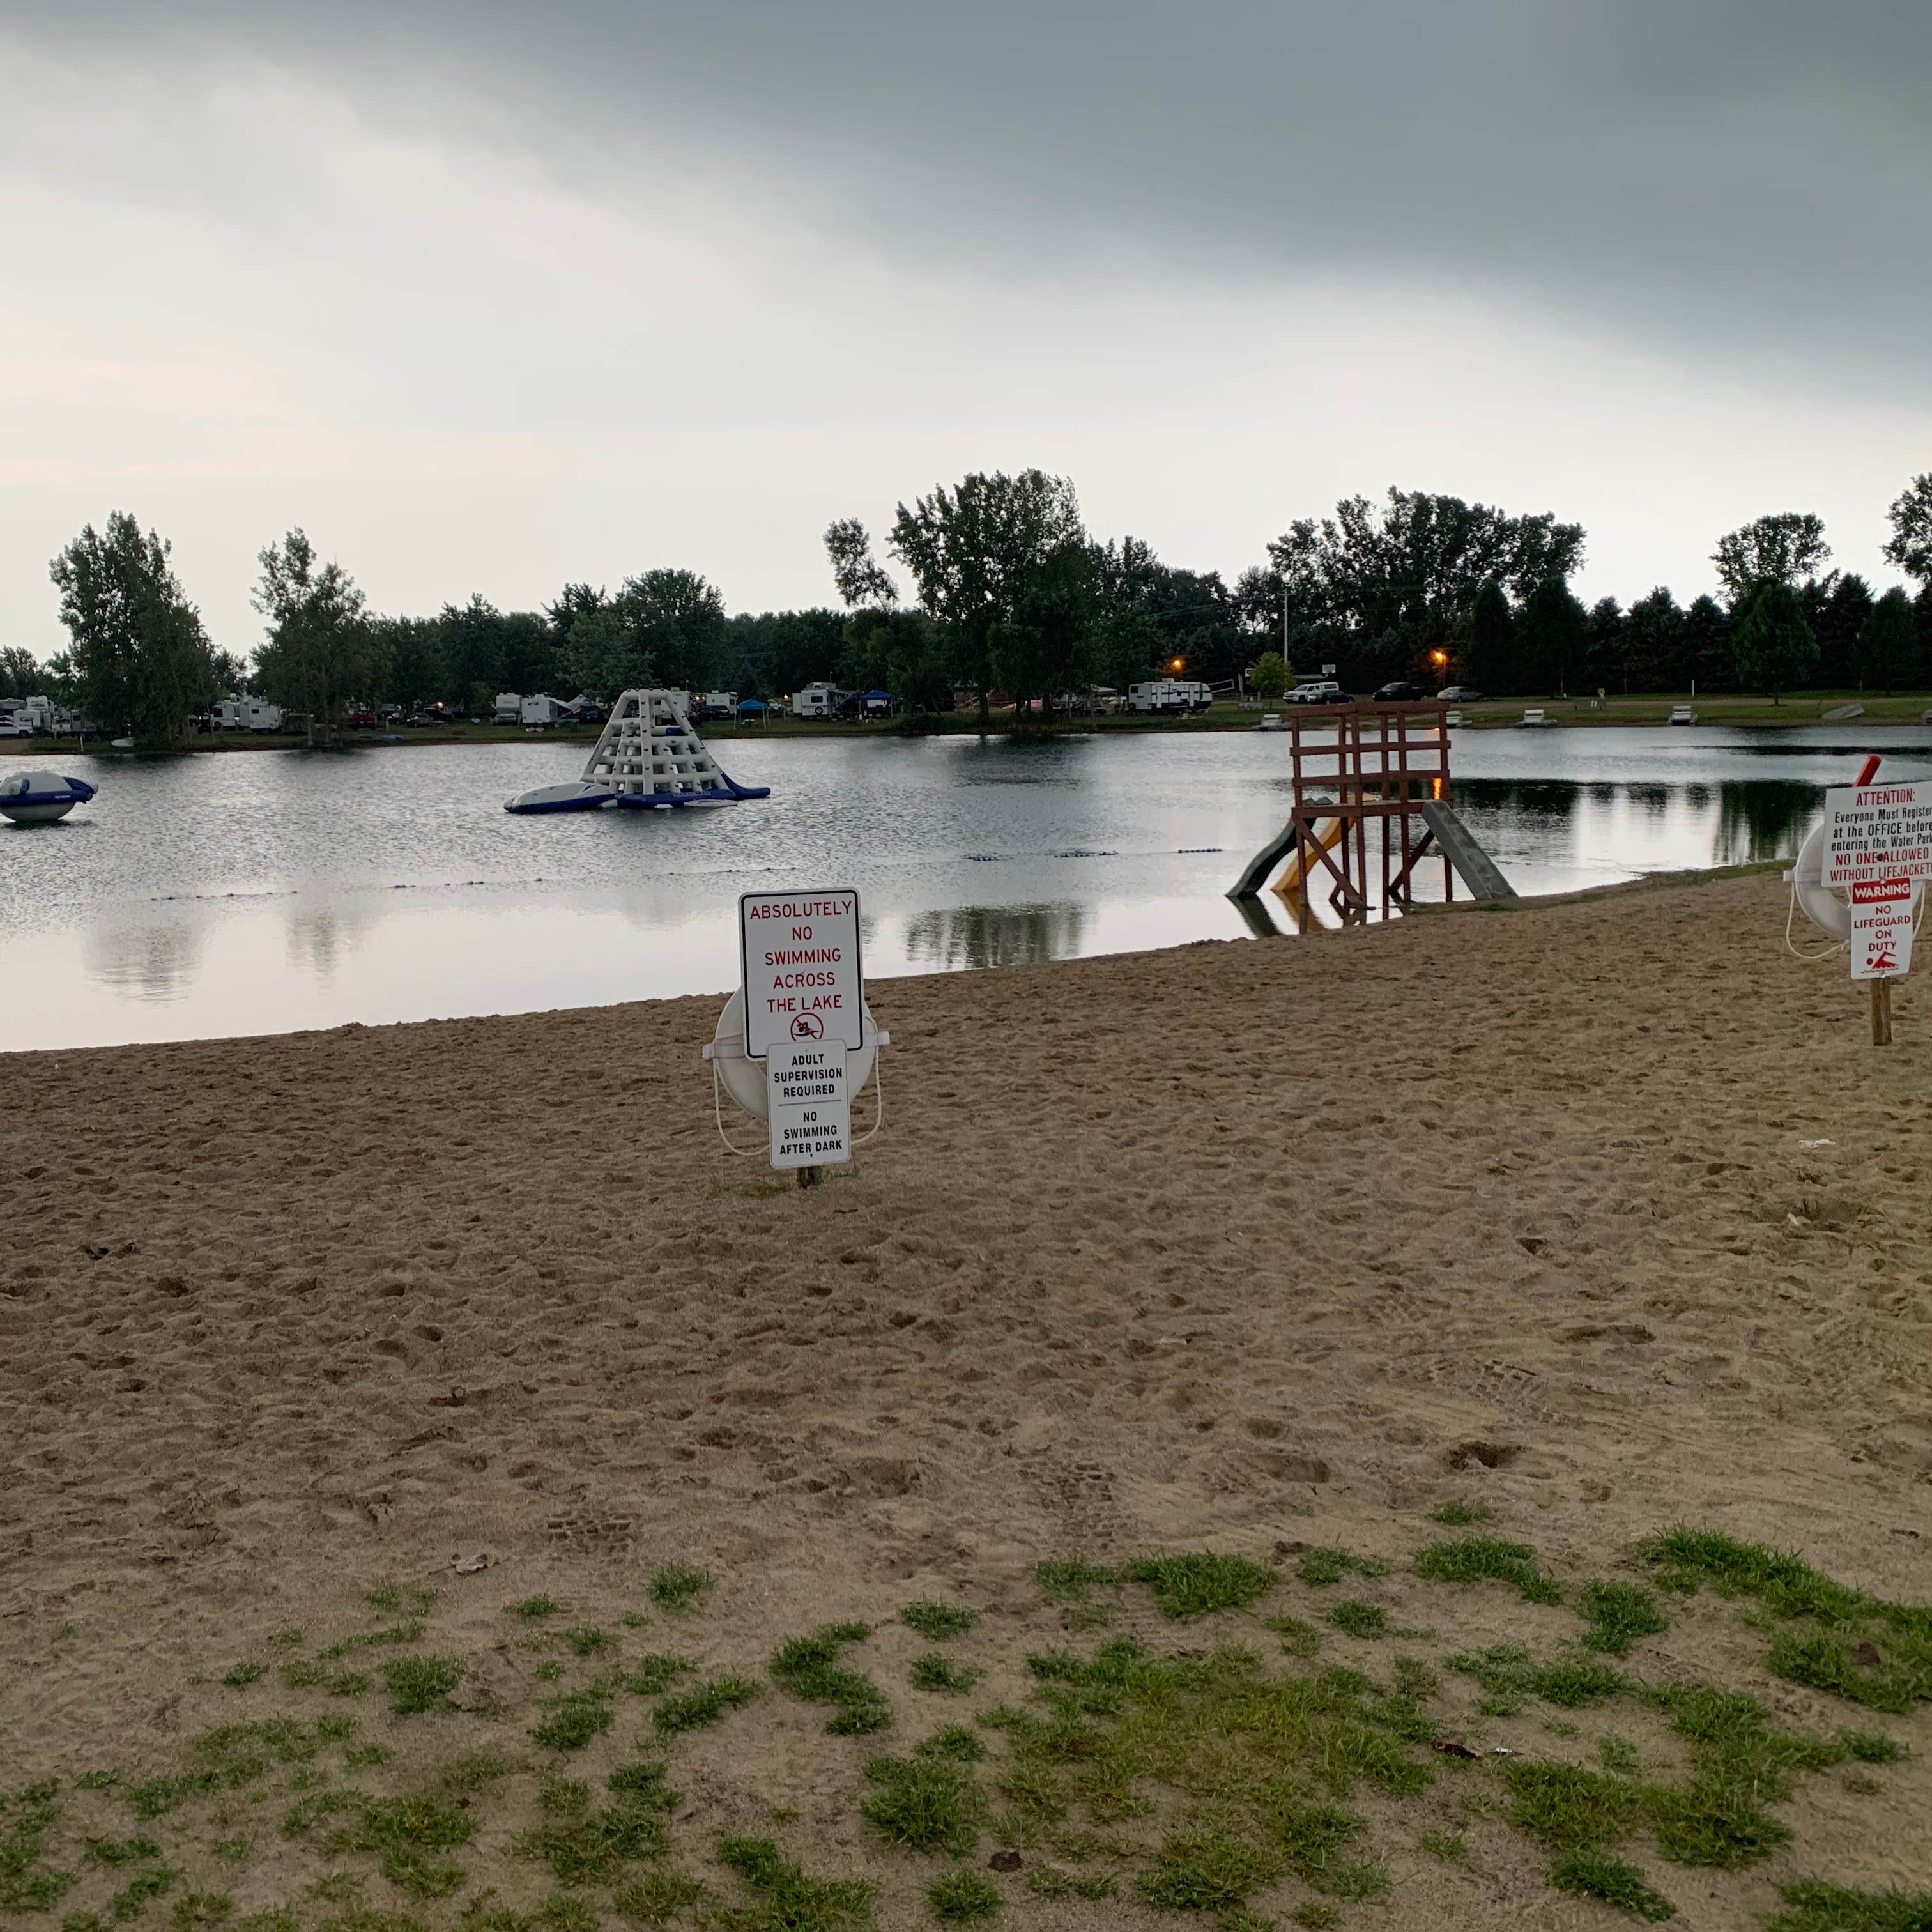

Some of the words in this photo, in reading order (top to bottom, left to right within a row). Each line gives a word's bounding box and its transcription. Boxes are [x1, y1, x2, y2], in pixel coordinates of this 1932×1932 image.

[1857, 788, 1915, 806] ATTENTION:
[1835, 811, 1874, 824] Everyone
[1878, 808, 1899, 820] Must
[1902, 806, 1932, 819] Register
[1833, 827, 1843, 838] at
[1848, 826, 1862, 837] the
[1868, 822, 1902, 836] OFFICE
[1906, 820, 1932, 833] before
[1831, 839, 1868, 851] entering
[1873, 837, 1887, 848] the
[1891, 835, 1913, 847] Water
[1836, 854, 1850, 866] NO
[1856, 852, 1878, 864] ONE
[1883, 847, 1929, 862] ALLOWED
[1830, 868, 1874, 882] WITHOUT
[1878, 862, 1932, 880] LIFEJACKET
[1854, 883, 1910, 898] WARNING
[750, 901, 852, 919] ABSOLUTELY
[1876, 905, 1891, 915] NO
[1854, 915, 1910, 929] LIFEGUARD
[792, 926, 812, 940] NO
[1875, 929, 1892, 939] ON
[1869, 941, 1896, 951] DUTY
[765, 948, 841, 966] SWIMMING
[774, 972, 835, 989] ACROSS
[767, 998, 796, 1013] THE
[802, 995, 842, 1010] LAKE
[792, 1054, 824, 1066] ADULT
[774, 1068, 843, 1083] SUPERVISION
[783, 1084, 834, 1098] REQUIRED
[803, 1112, 817, 1122] NO
[784, 1125, 837, 1139] SWIMMING
[780, 1144, 811, 1154] AFTER
[816, 1140, 842, 1152] DARK
